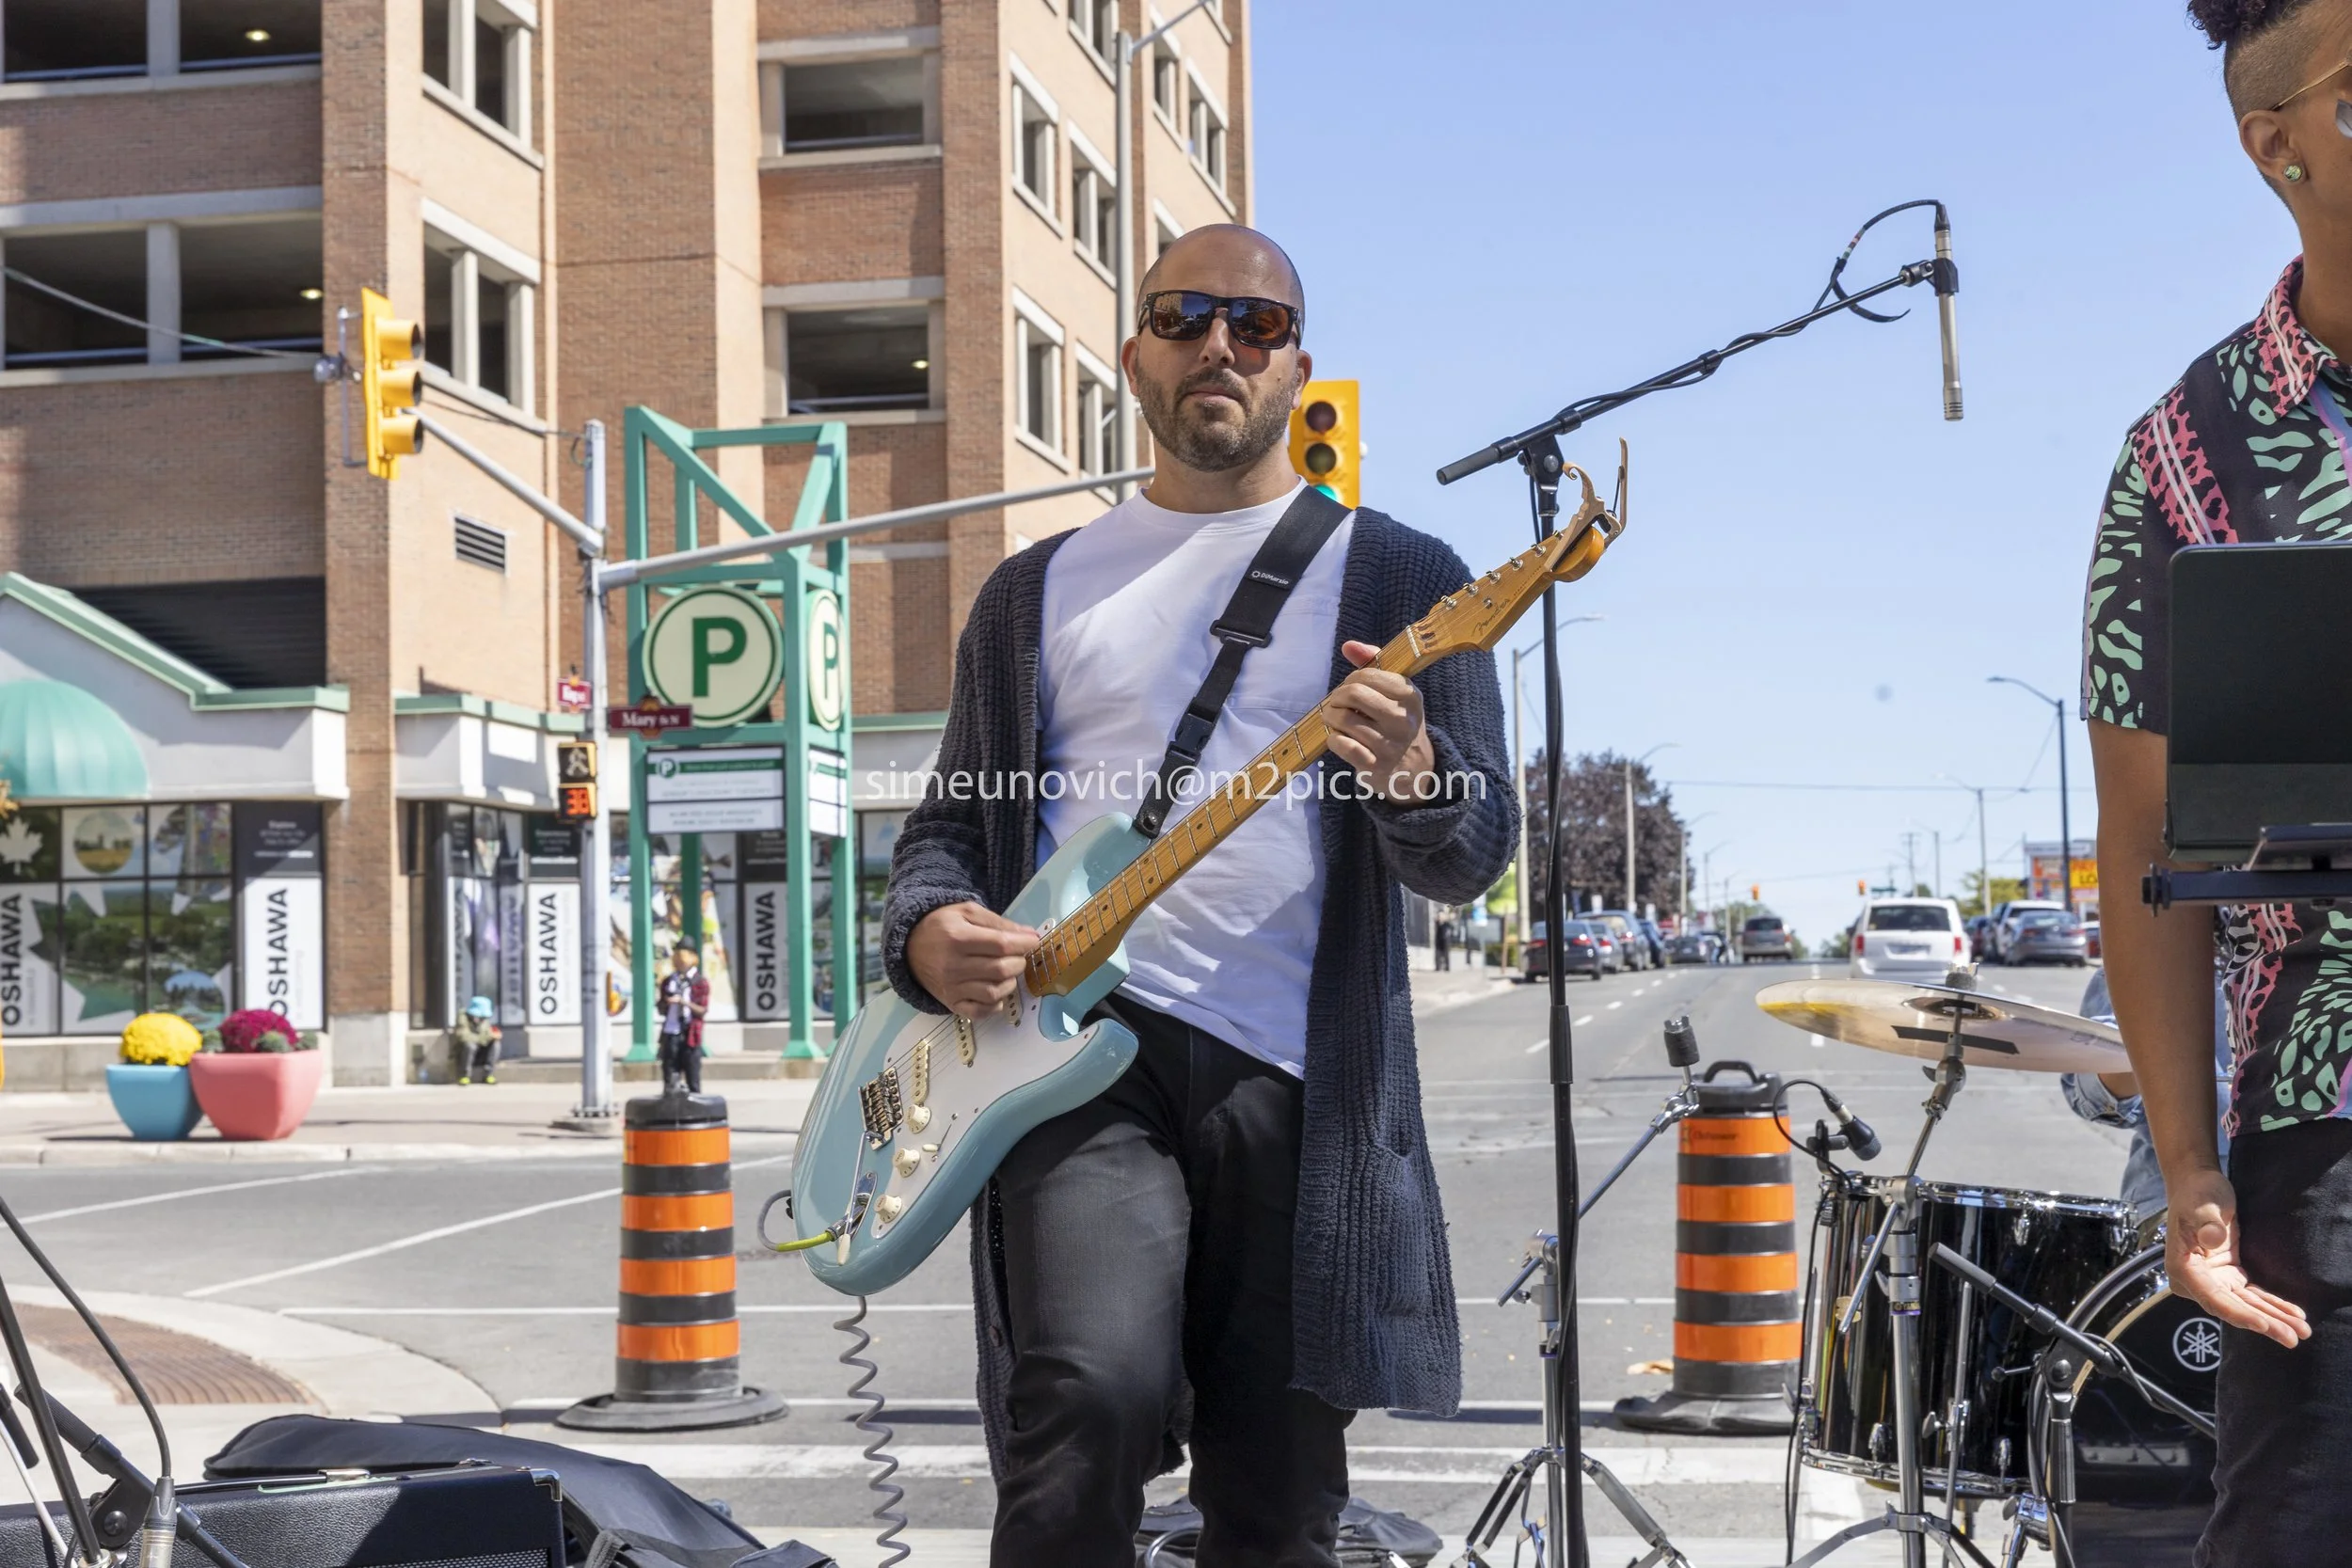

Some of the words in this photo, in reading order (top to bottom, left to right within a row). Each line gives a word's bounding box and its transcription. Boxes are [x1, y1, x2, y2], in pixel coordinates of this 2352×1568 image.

[1260, 572, 1289, 585] DiMarzio
[691, 616, 747, 698] P
[823, 621, 839, 700] P
[621, 712, 657, 728] Mary
[566, 789, 589, 816] 38
[1, 893, 22, 1026] OSHAWA
[267, 888, 288, 1018] OSHAWA
[539, 893, 558, 1015] OSHAWA
[755, 891, 776, 1012] OSHAWA
